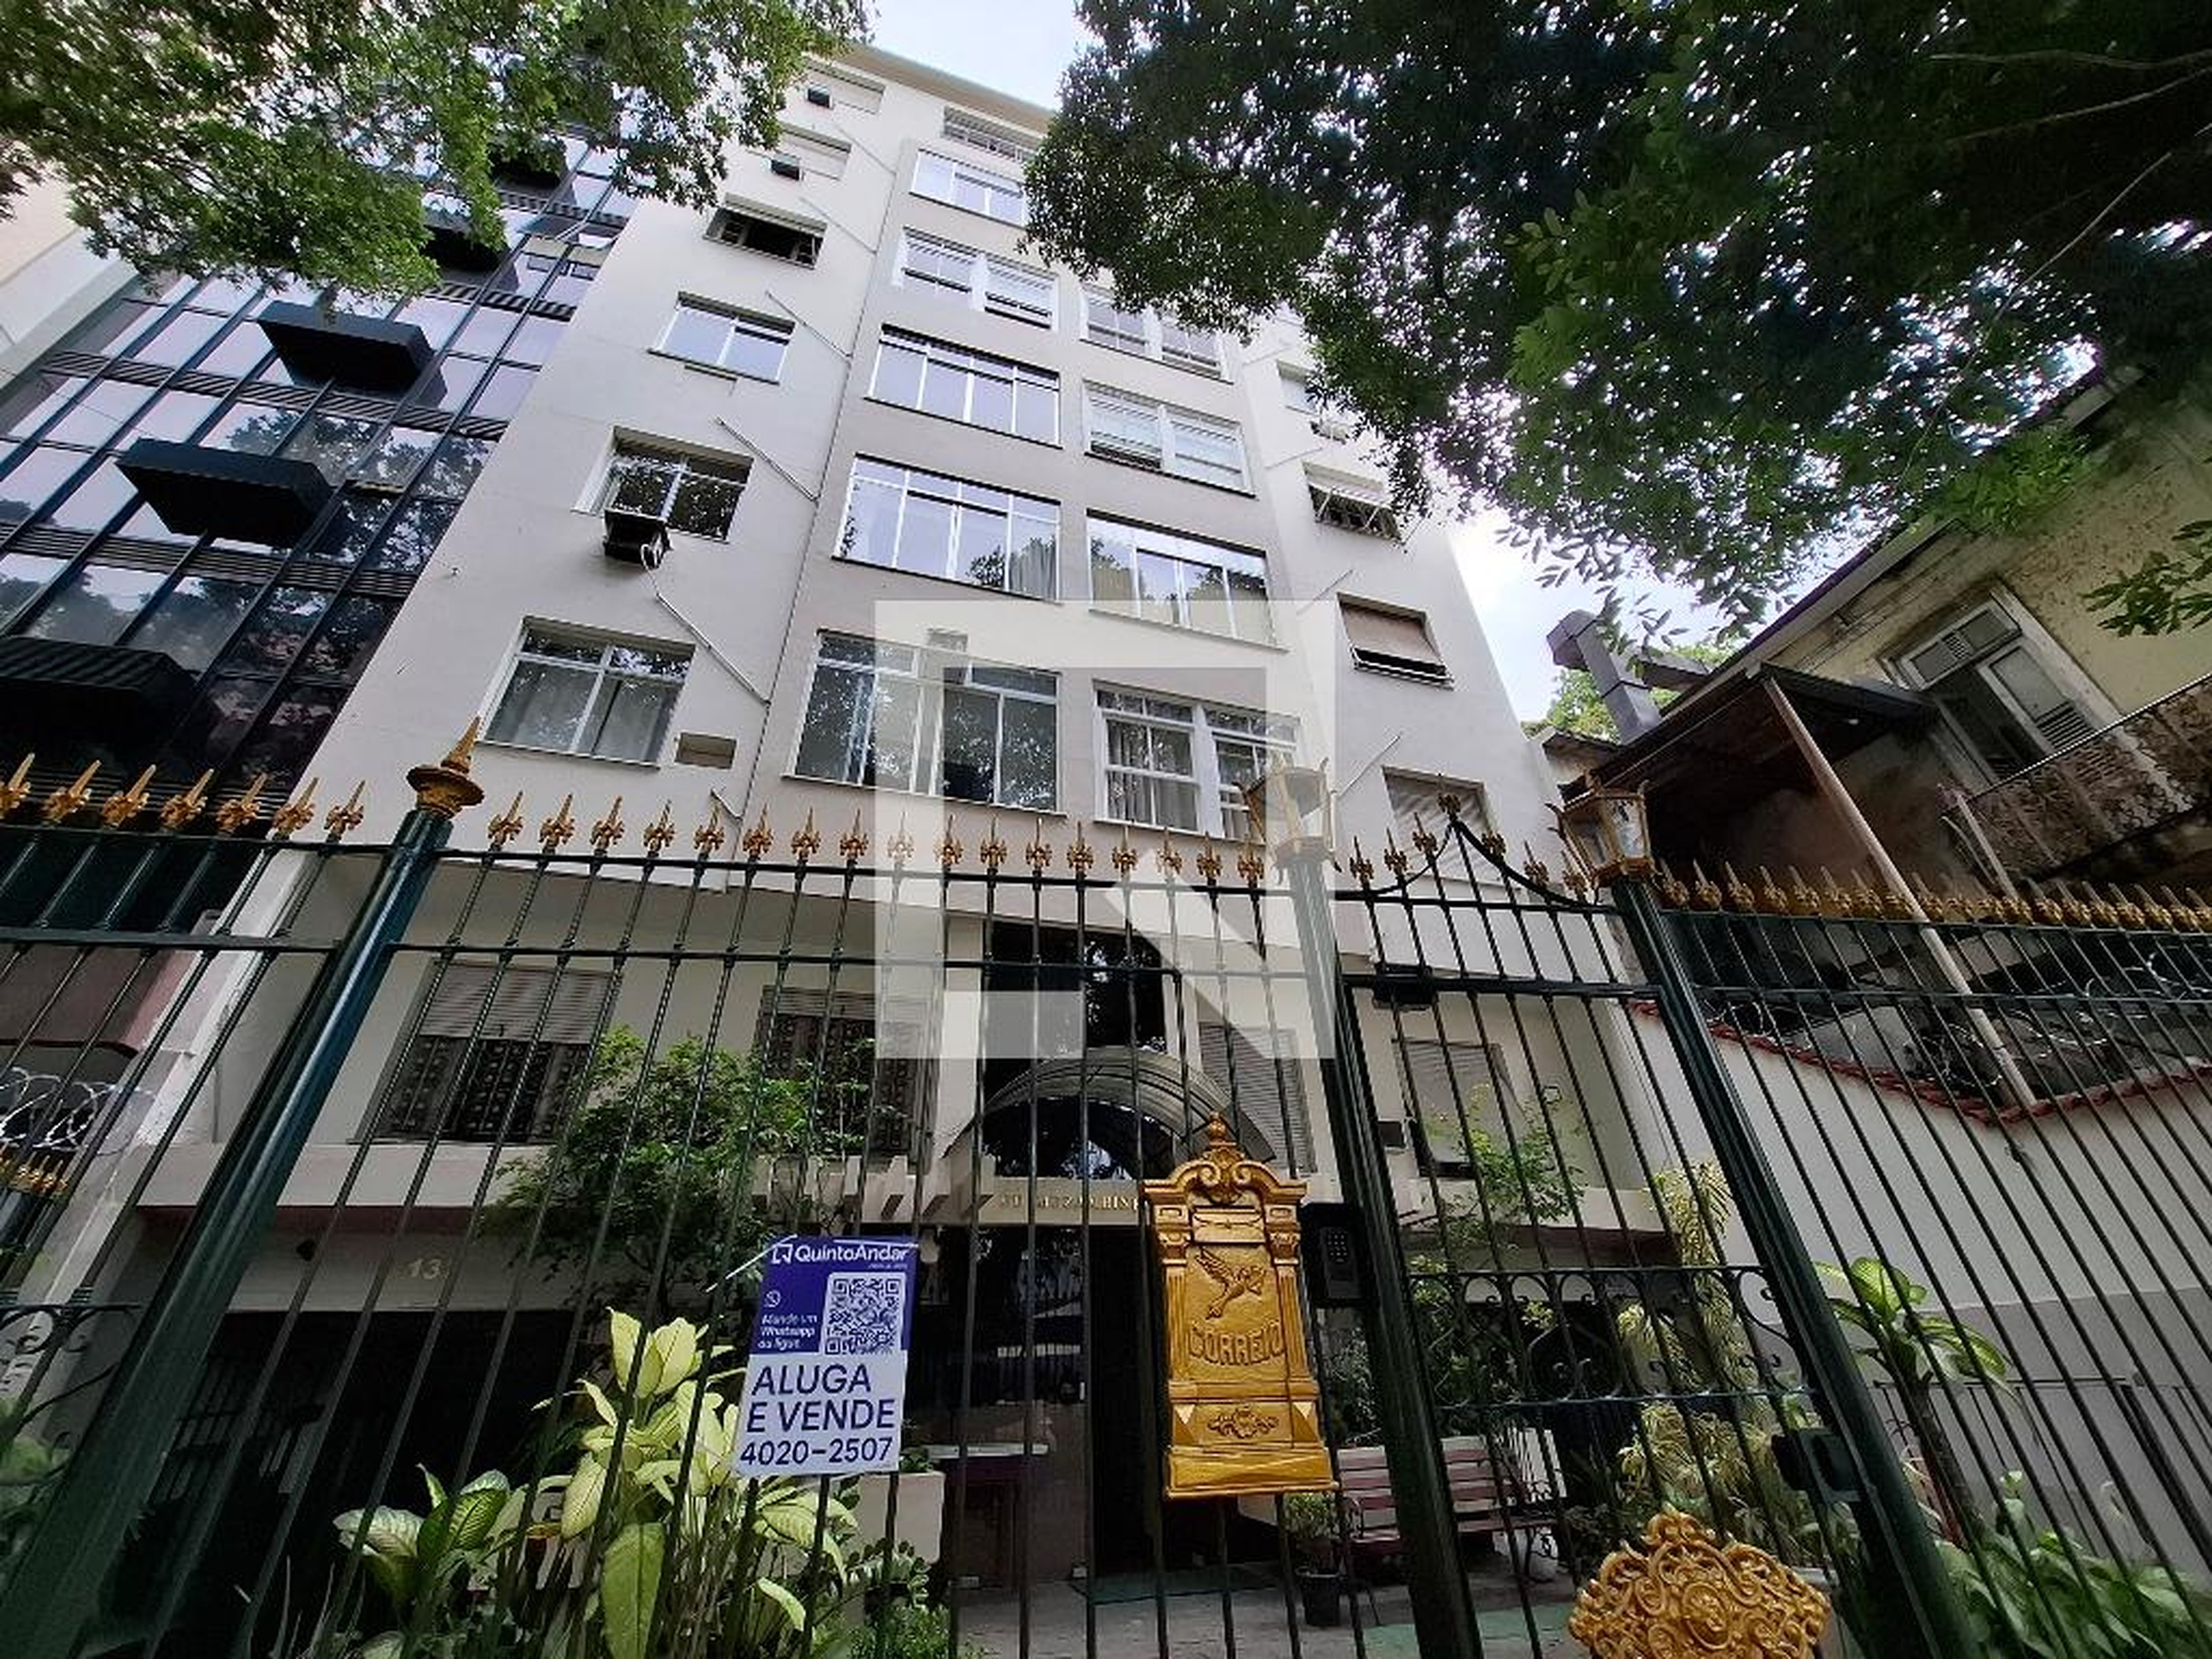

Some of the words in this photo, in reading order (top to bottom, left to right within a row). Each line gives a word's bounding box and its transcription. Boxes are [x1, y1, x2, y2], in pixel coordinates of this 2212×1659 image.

[795, 1244, 909, 1262] QuintoAndar
[1189, 1320, 1284, 1366] CORREIO
[751, 1363, 872, 1396] ALUGA
[747, 1402, 768, 1433] E
[778, 1399, 895, 1432] VENDE
[740, 1437, 893, 1465] 4020-2507
